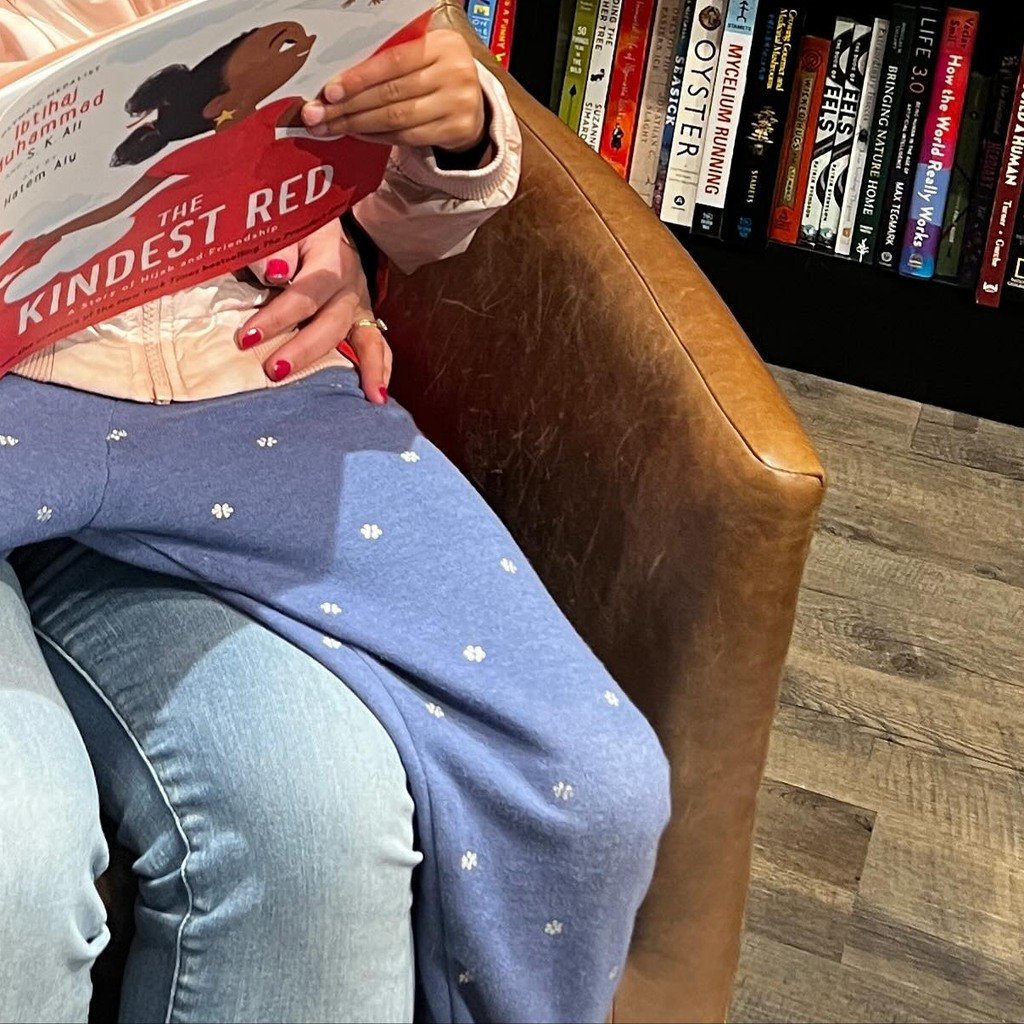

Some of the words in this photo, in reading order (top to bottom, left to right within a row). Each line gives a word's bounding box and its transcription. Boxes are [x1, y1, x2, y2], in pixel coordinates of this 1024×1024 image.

[595, 25, 606, 51] TREE
[605, 27, 615, 47] THE
[914, 16, 937, 59] LIFE
[717, 44, 744, 124] MYCELIUM
[908, 65, 928, 94] 3.0
[946, 54, 963, 86] How
[676, 39, 716, 158] OYSTER
[818, 85, 839, 132] EELS
[837, 86, 860, 136] EELS
[878, 64, 898, 127] BRINGING
[938, 88, 956, 113] the
[869, 129, 888, 179] NATURE
[930, 115, 952, 157] World
[704, 126, 729, 196] RUNNING
[917, 159, 942, 203] Really
[4, 171, 45, 208] Hatem
[157, 194, 204, 226] THE
[862, 180, 879, 216] HOME
[912, 207, 934, 248] Works
[17, 205, 227, 336] KINDEST
[245, 165, 334, 229] RED
